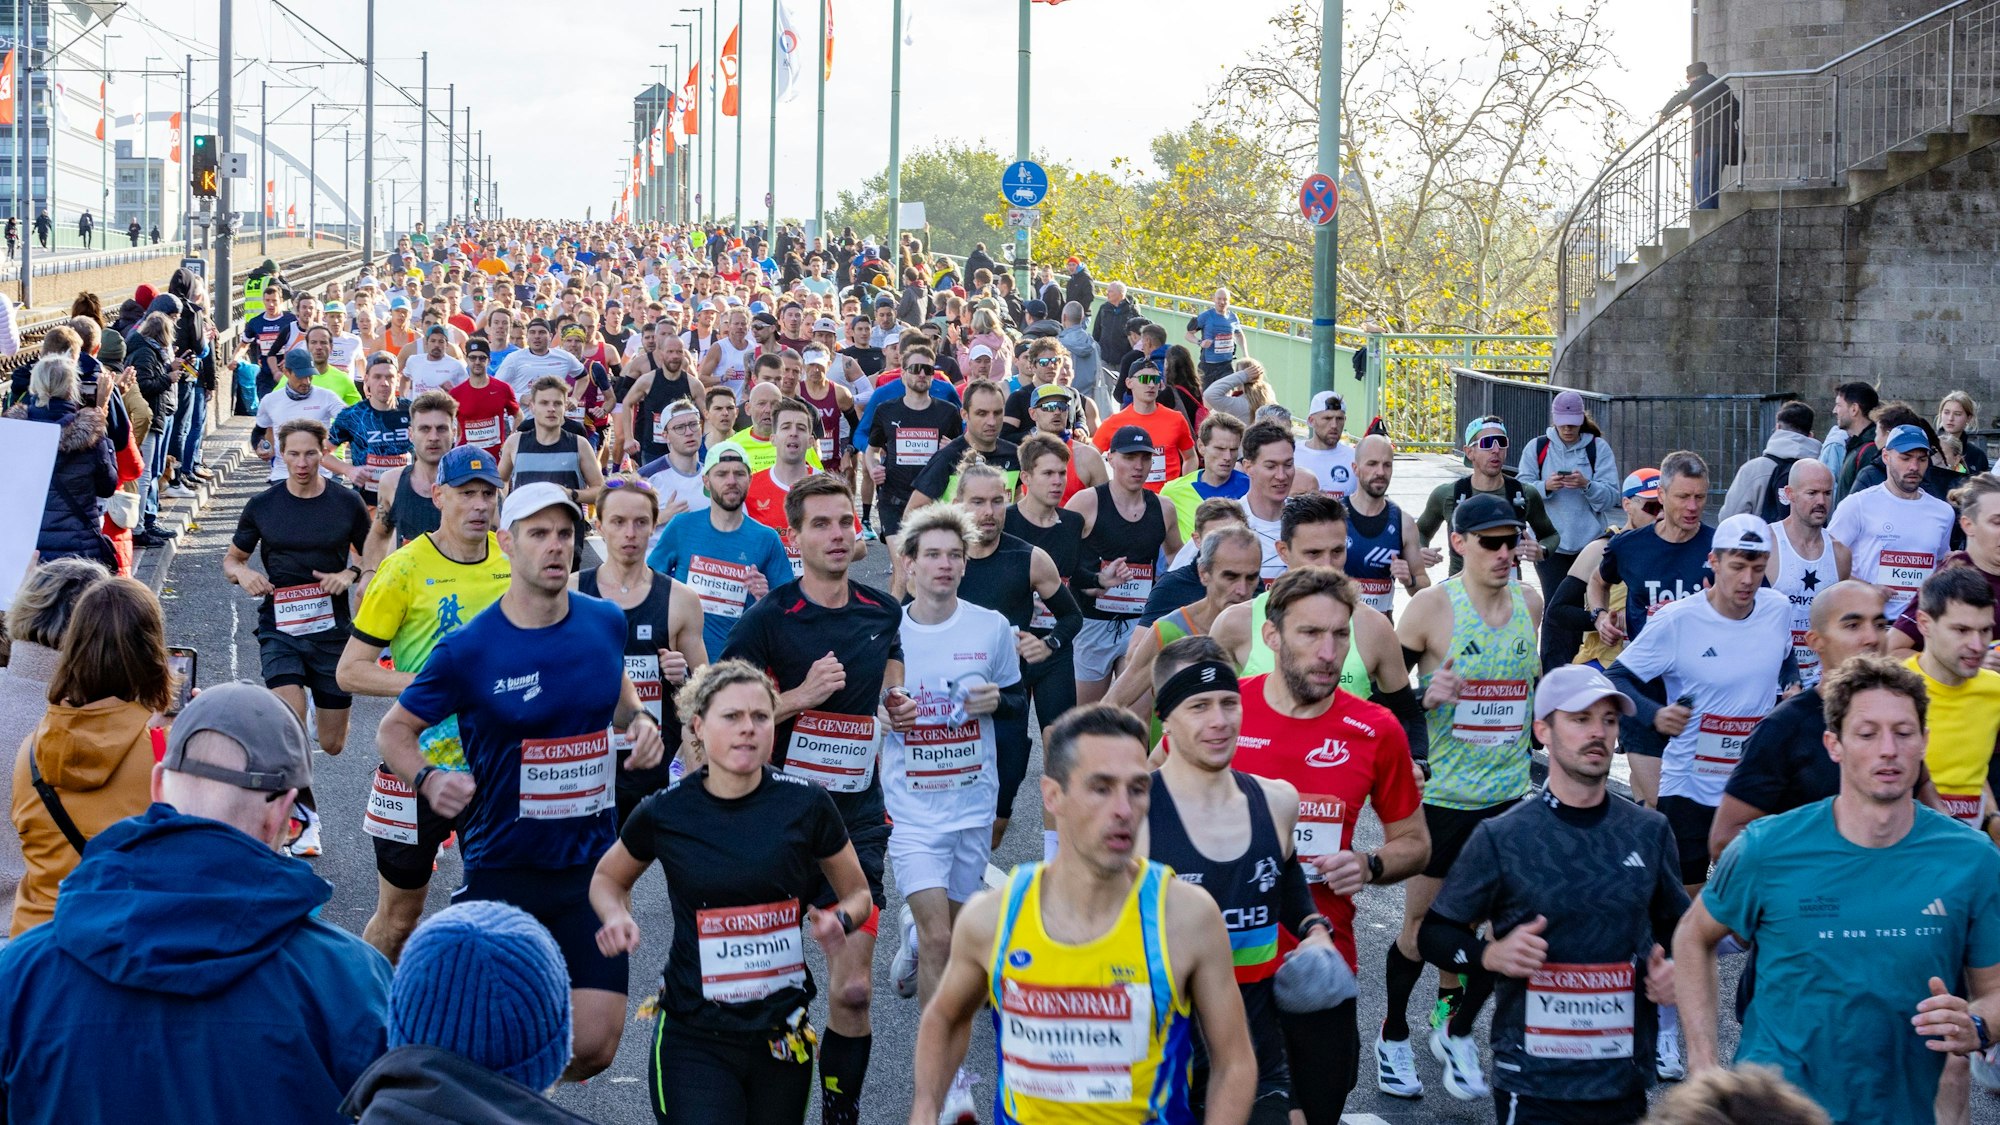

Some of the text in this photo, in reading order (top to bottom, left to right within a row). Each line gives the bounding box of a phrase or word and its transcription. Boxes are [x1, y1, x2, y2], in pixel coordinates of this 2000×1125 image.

[204, 170, 216, 190] K
[468, 427, 495, 436] Mathieu
[905, 440, 929, 448] David
[1895, 555, 1933, 566] GENERALI
[704, 561, 745, 578] GENERAL
[1892, 568, 1923, 580] Kevin
[691, 575, 744, 594] Christian
[1360, 582, 1392, 592] ENERALI
[286, 587, 328, 599] GENERAL
[278, 600, 328, 614] Johannes
[624, 658, 647, 668] ERS
[974, 652, 988, 660] 2025
[628, 670, 657, 679] ONIA
[636, 685, 660, 698] RALI
[1477, 684, 1527, 697] GENERALI
[940, 703, 956, 716] DA
[1471, 702, 1514, 716] Julian
[817, 718, 874, 736] GENERALI
[923, 724, 979, 740] GENERALI
[796, 736, 868, 757] Domenico
[1237, 735, 1271, 746] TERSPORT
[546, 737, 608, 759] GENERALI
[912, 743, 975, 762] Raphael
[821, 757, 842, 766] 32244
[527, 763, 604, 781] Sebastian
[376, 778, 413, 793] NERALI
[1298, 801, 1342, 818] ERALI
[1294, 828, 1313, 842] ns
[725, 907, 798, 931] GENERALI
[1819, 927, 1943, 939] WE RUN THIS CITY
[716, 935, 790, 960] Jasmin
[1554, 970, 1632, 989] GENERALI
[1027, 990, 1128, 1016] GENERALI
[1538, 994, 1625, 1015] Yannick
[1009, 1016, 1124, 1048] Dominiek
